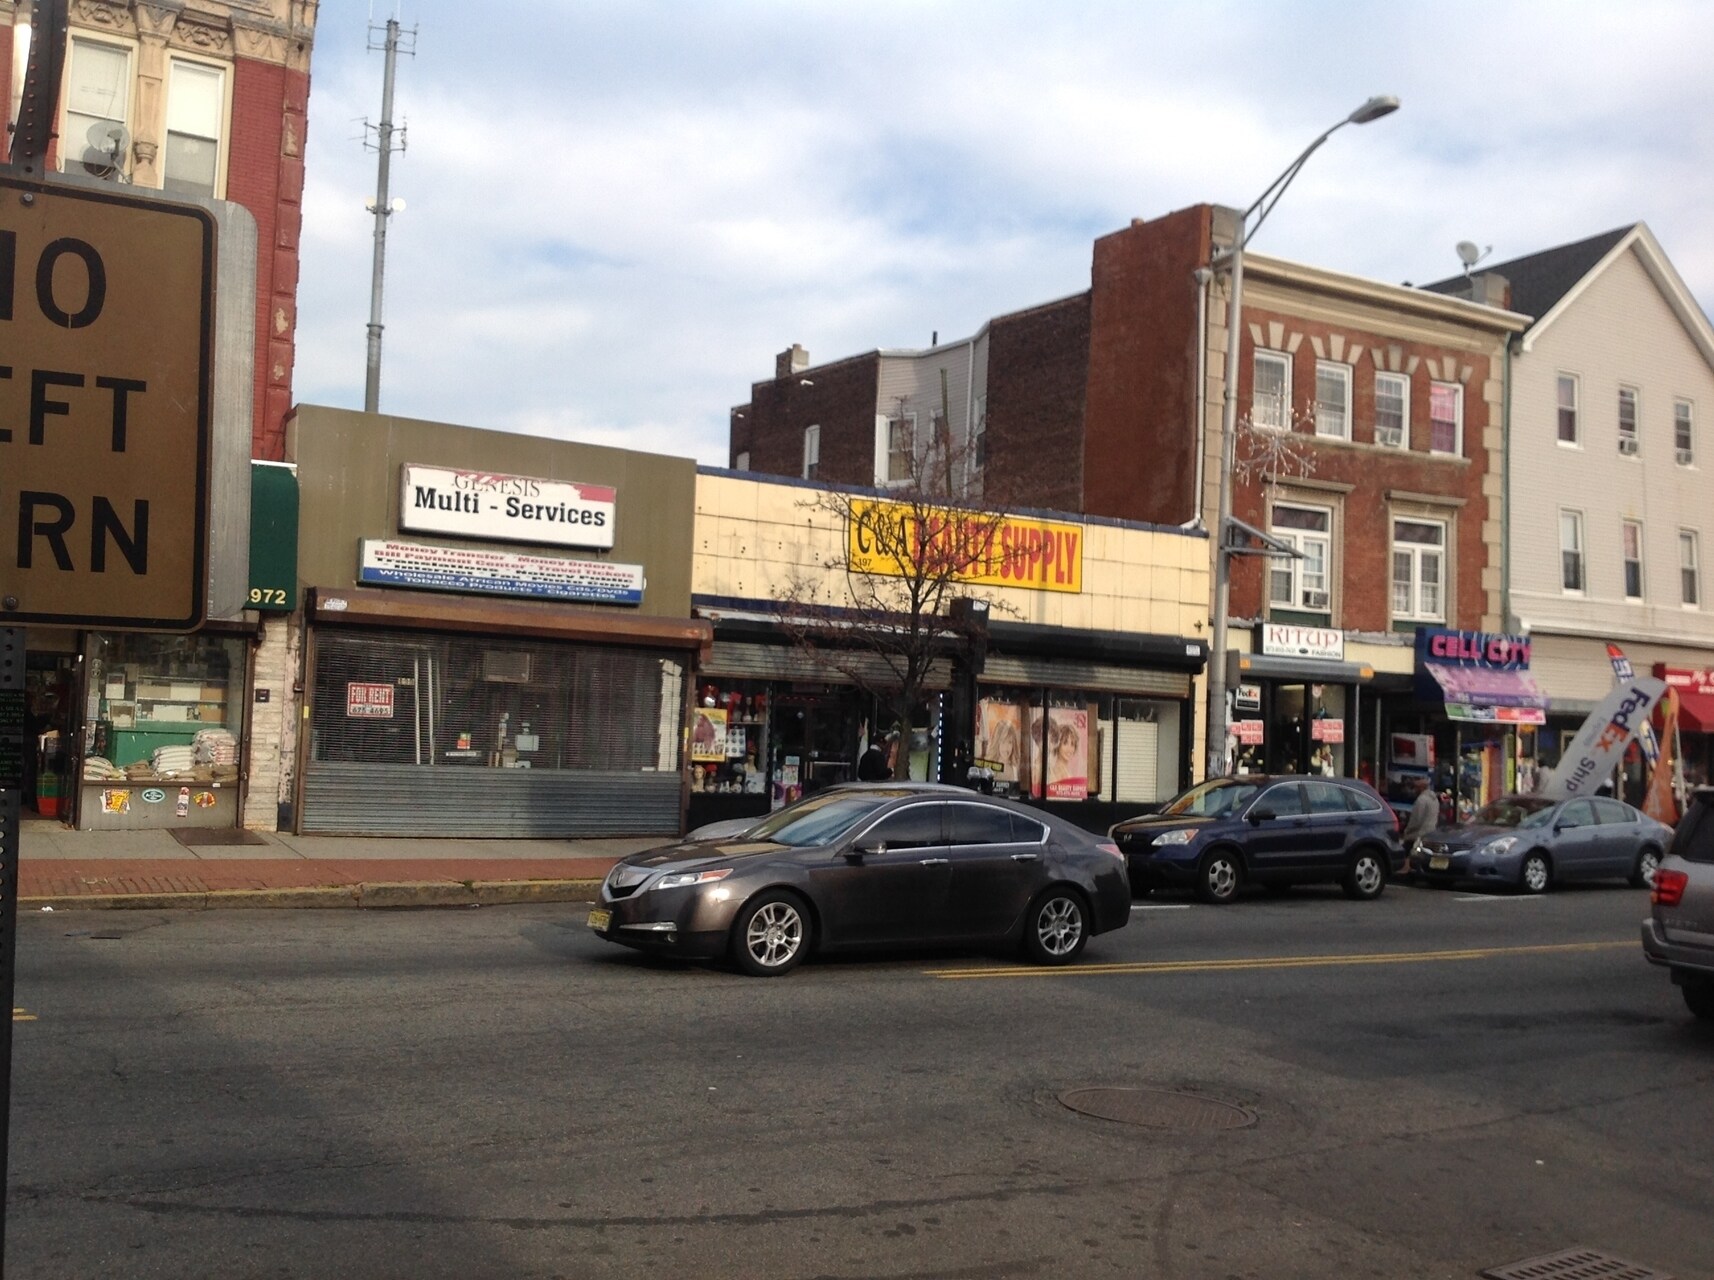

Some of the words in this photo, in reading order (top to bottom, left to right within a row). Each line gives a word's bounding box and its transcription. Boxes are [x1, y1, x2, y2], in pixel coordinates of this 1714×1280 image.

[0, 228, 107, 329] O
[415, 486, 480, 514] Multi
[506, 496, 606, 528] Services
[1000, 522, 1078, 586] SUPPLY
[379, 568, 456, 581] Wholesale
[459, 576, 511, 586] African
[515, 580, 563, 590] Movies
[405, 576, 465, 587] Tobacco
[469, 582, 533, 593] Products
[247, 587, 287, 605] 972
[1432, 634, 1482, 660] CELL
[351, 685, 367, 703] FOR
[368, 687, 391, 704] RENT
[1596, 686, 1651, 753] FedEx
[1565, 757, 1596, 792] Ship
